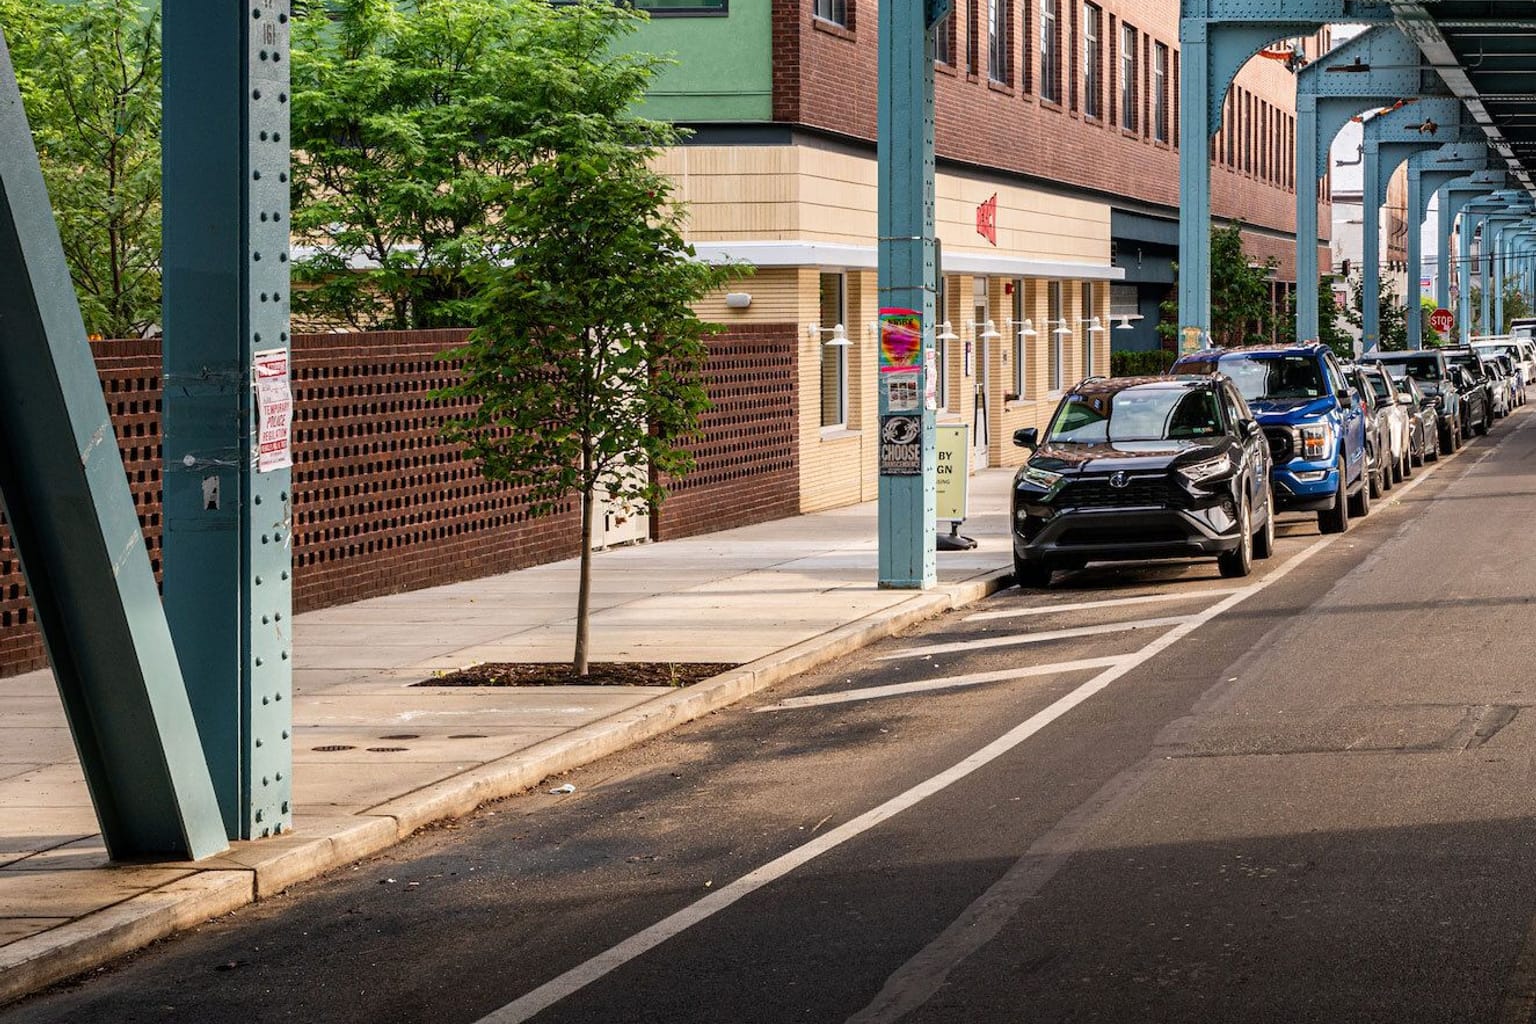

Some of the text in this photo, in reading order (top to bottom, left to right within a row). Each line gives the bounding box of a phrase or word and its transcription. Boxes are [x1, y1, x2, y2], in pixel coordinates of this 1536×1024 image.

[1431, 316, 1452, 327] STOP
[267, 415, 286, 429] POLICE
[881, 444, 920, 461] CHOOSE
[938, 451, 952, 460] BY
